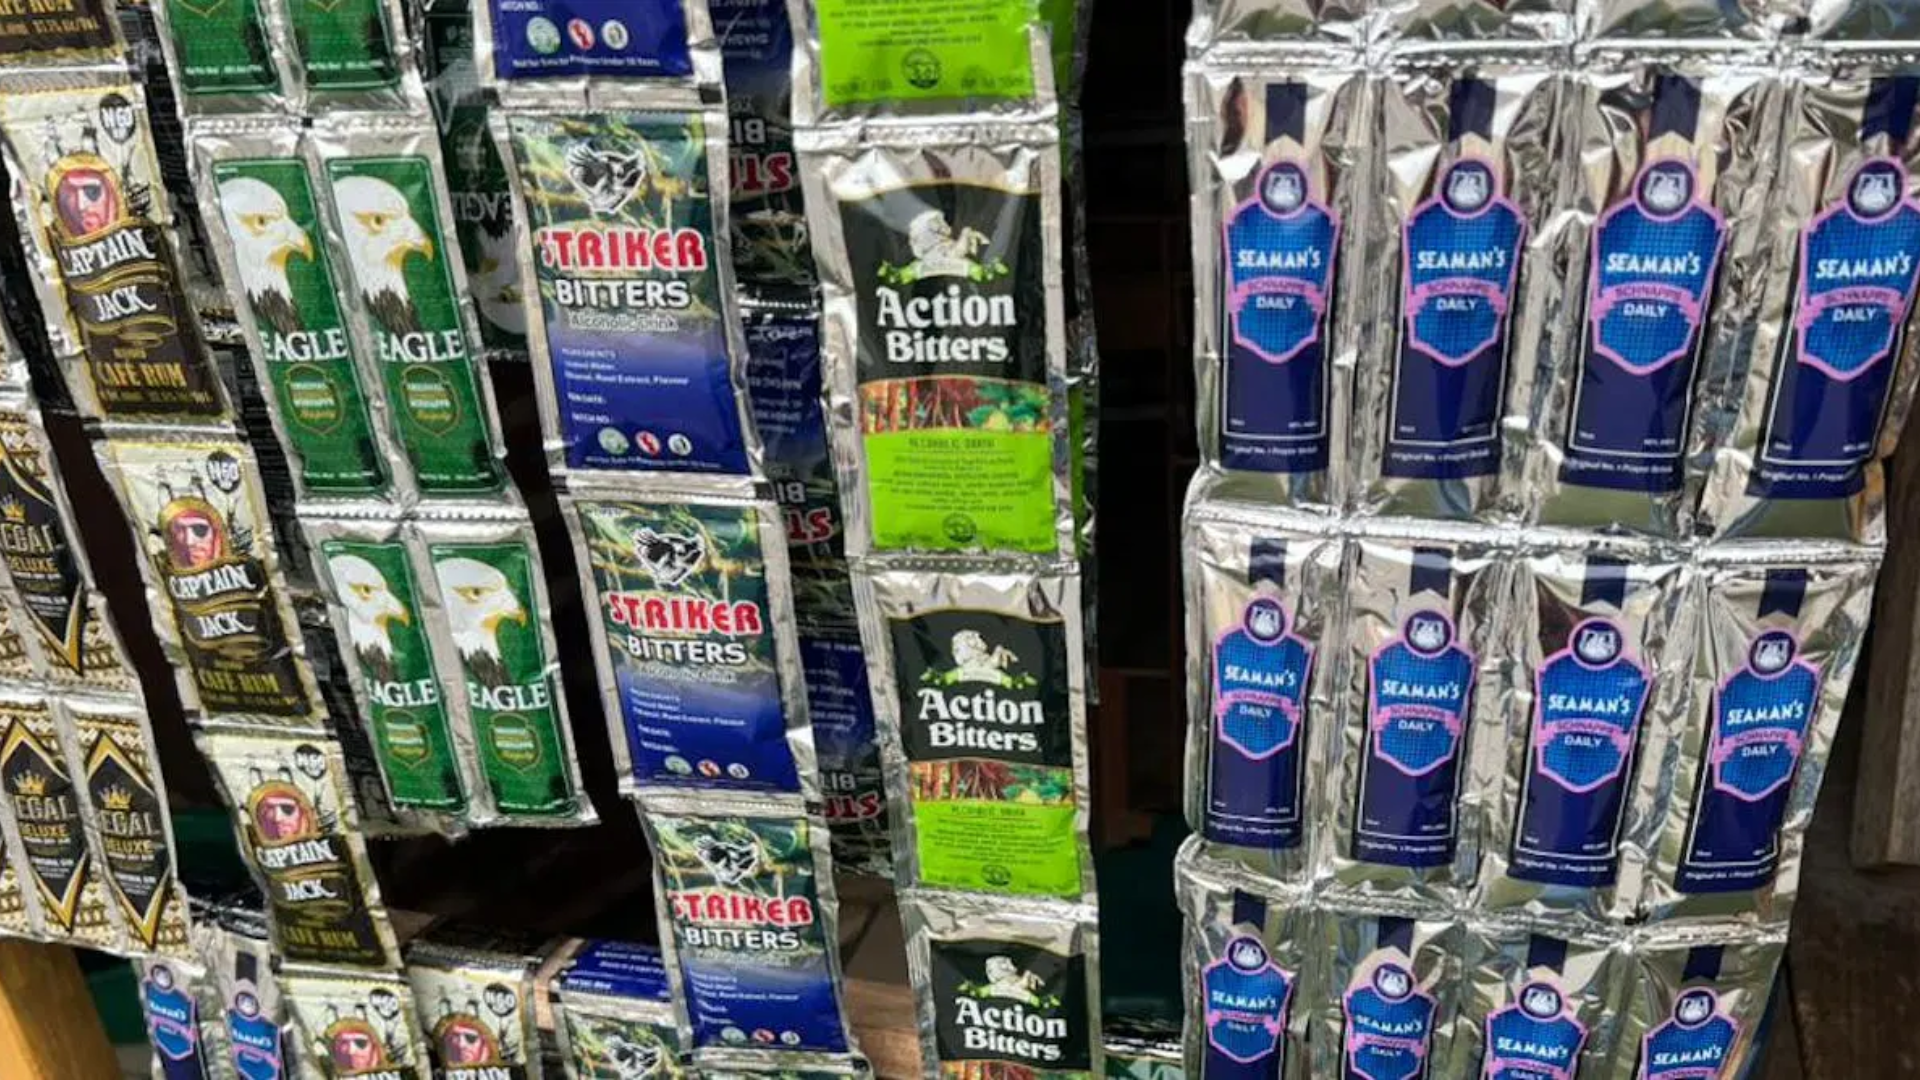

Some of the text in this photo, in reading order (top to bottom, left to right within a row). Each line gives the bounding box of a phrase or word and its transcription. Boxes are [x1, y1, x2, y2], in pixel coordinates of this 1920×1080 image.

[1237, 247, 1322, 269] SEAMAN'S
[1416, 247, 1506, 270] SEAMAN'S
[1606, 251, 1701, 275] SEAMAN'S
[1815, 250, 1912, 279] SEAMAN'S
[94, 285, 157, 322] JACK
[555, 279, 691, 308] BITTERS
[1256, 296, 1295, 309] DAILY
[876, 285, 1017, 328] Action
[1436, 298, 1477, 312] DAILY
[1623, 303, 1668, 318] DAILY
[1832, 306, 1878, 322] DAILY
[886, 331, 1009, 364] Bitters
[606, 593, 763, 635] STRIKER
[197, 611, 255, 640] JACK
[627, 635, 748, 665] BITTERS
[1224, 665, 1297, 687] SEAMAN'S
[1381, 679, 1460, 700] SEAMAN'S
[918, 688, 1045, 725] Action
[1239, 705, 1272, 719] DAILY
[1548, 694, 1630, 715] SEAMAN'S
[1726, 701, 1804, 725] SEAMAN'S
[929, 722, 1038, 751] Bitters
[1398, 720, 1435, 732] DAILY
[1564, 735, 1603, 748] DAILY
[1741, 745, 1778, 758] DAILY
[256, 840, 338, 870] CAPTAIN
[283, 880, 337, 901] JACK
[686, 928, 799, 950] BITTERS
[1211, 990, 1277, 1010] SEAMAN'S
[955, 996, 1067, 1039] Action
[1354, 1013, 1423, 1034] SEAMAN'S
[964, 1026, 1061, 1061] Bitters
[1497, 1036, 1568, 1058] SEAMAN'S
[1653, 1044, 1722, 1066] SEAMAN'S
